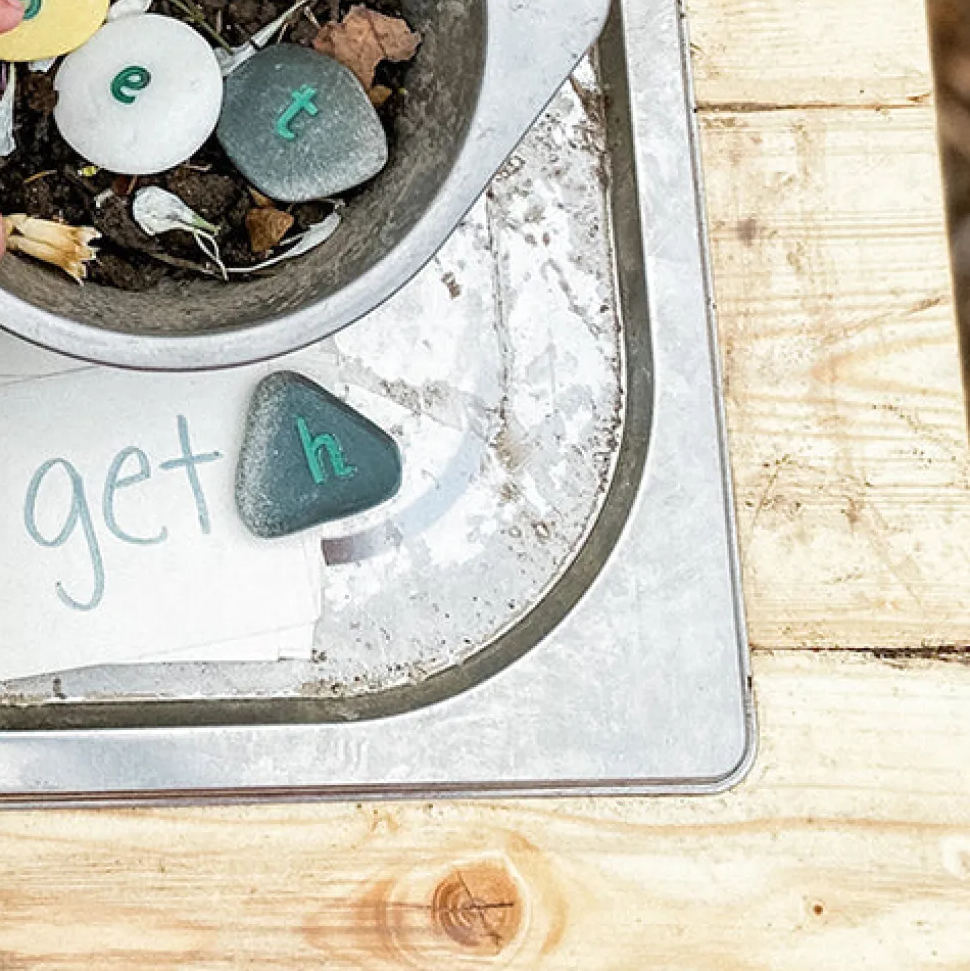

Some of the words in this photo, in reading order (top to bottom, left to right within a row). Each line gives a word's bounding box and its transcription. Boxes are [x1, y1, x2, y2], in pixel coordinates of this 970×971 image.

[109, 65, 152, 104] e
[295, 416, 358, 486] h
[23, 414, 220, 612] get
